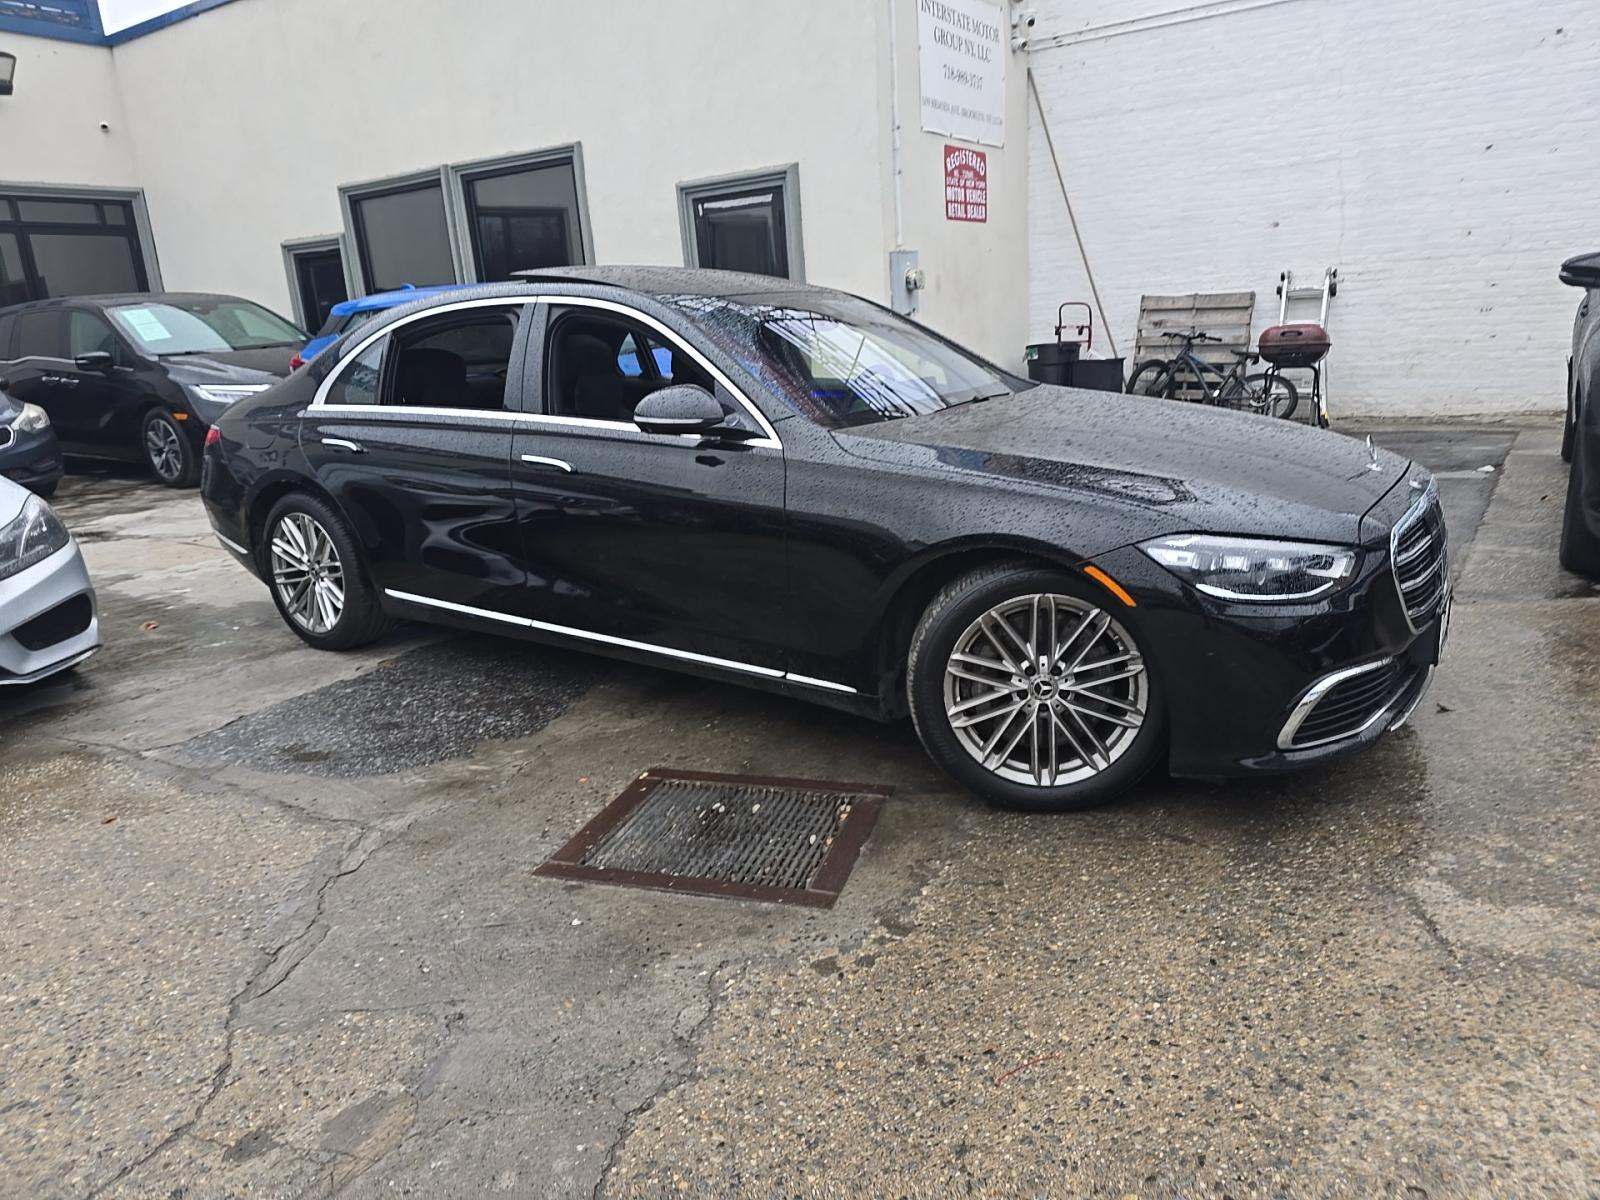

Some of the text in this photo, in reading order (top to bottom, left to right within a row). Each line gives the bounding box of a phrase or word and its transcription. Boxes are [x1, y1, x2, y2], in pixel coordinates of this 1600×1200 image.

[921, 0, 999, 43] INTERSTATE MOTOR
[933, 26, 963, 52] GROUP
[977, 43, 992, 63] LLC
[946, 149, 985, 176] REGISTERED
[946, 186, 986, 204] MOTOR VEHICLE
[948, 202, 986, 220] RETAIL DEALER
